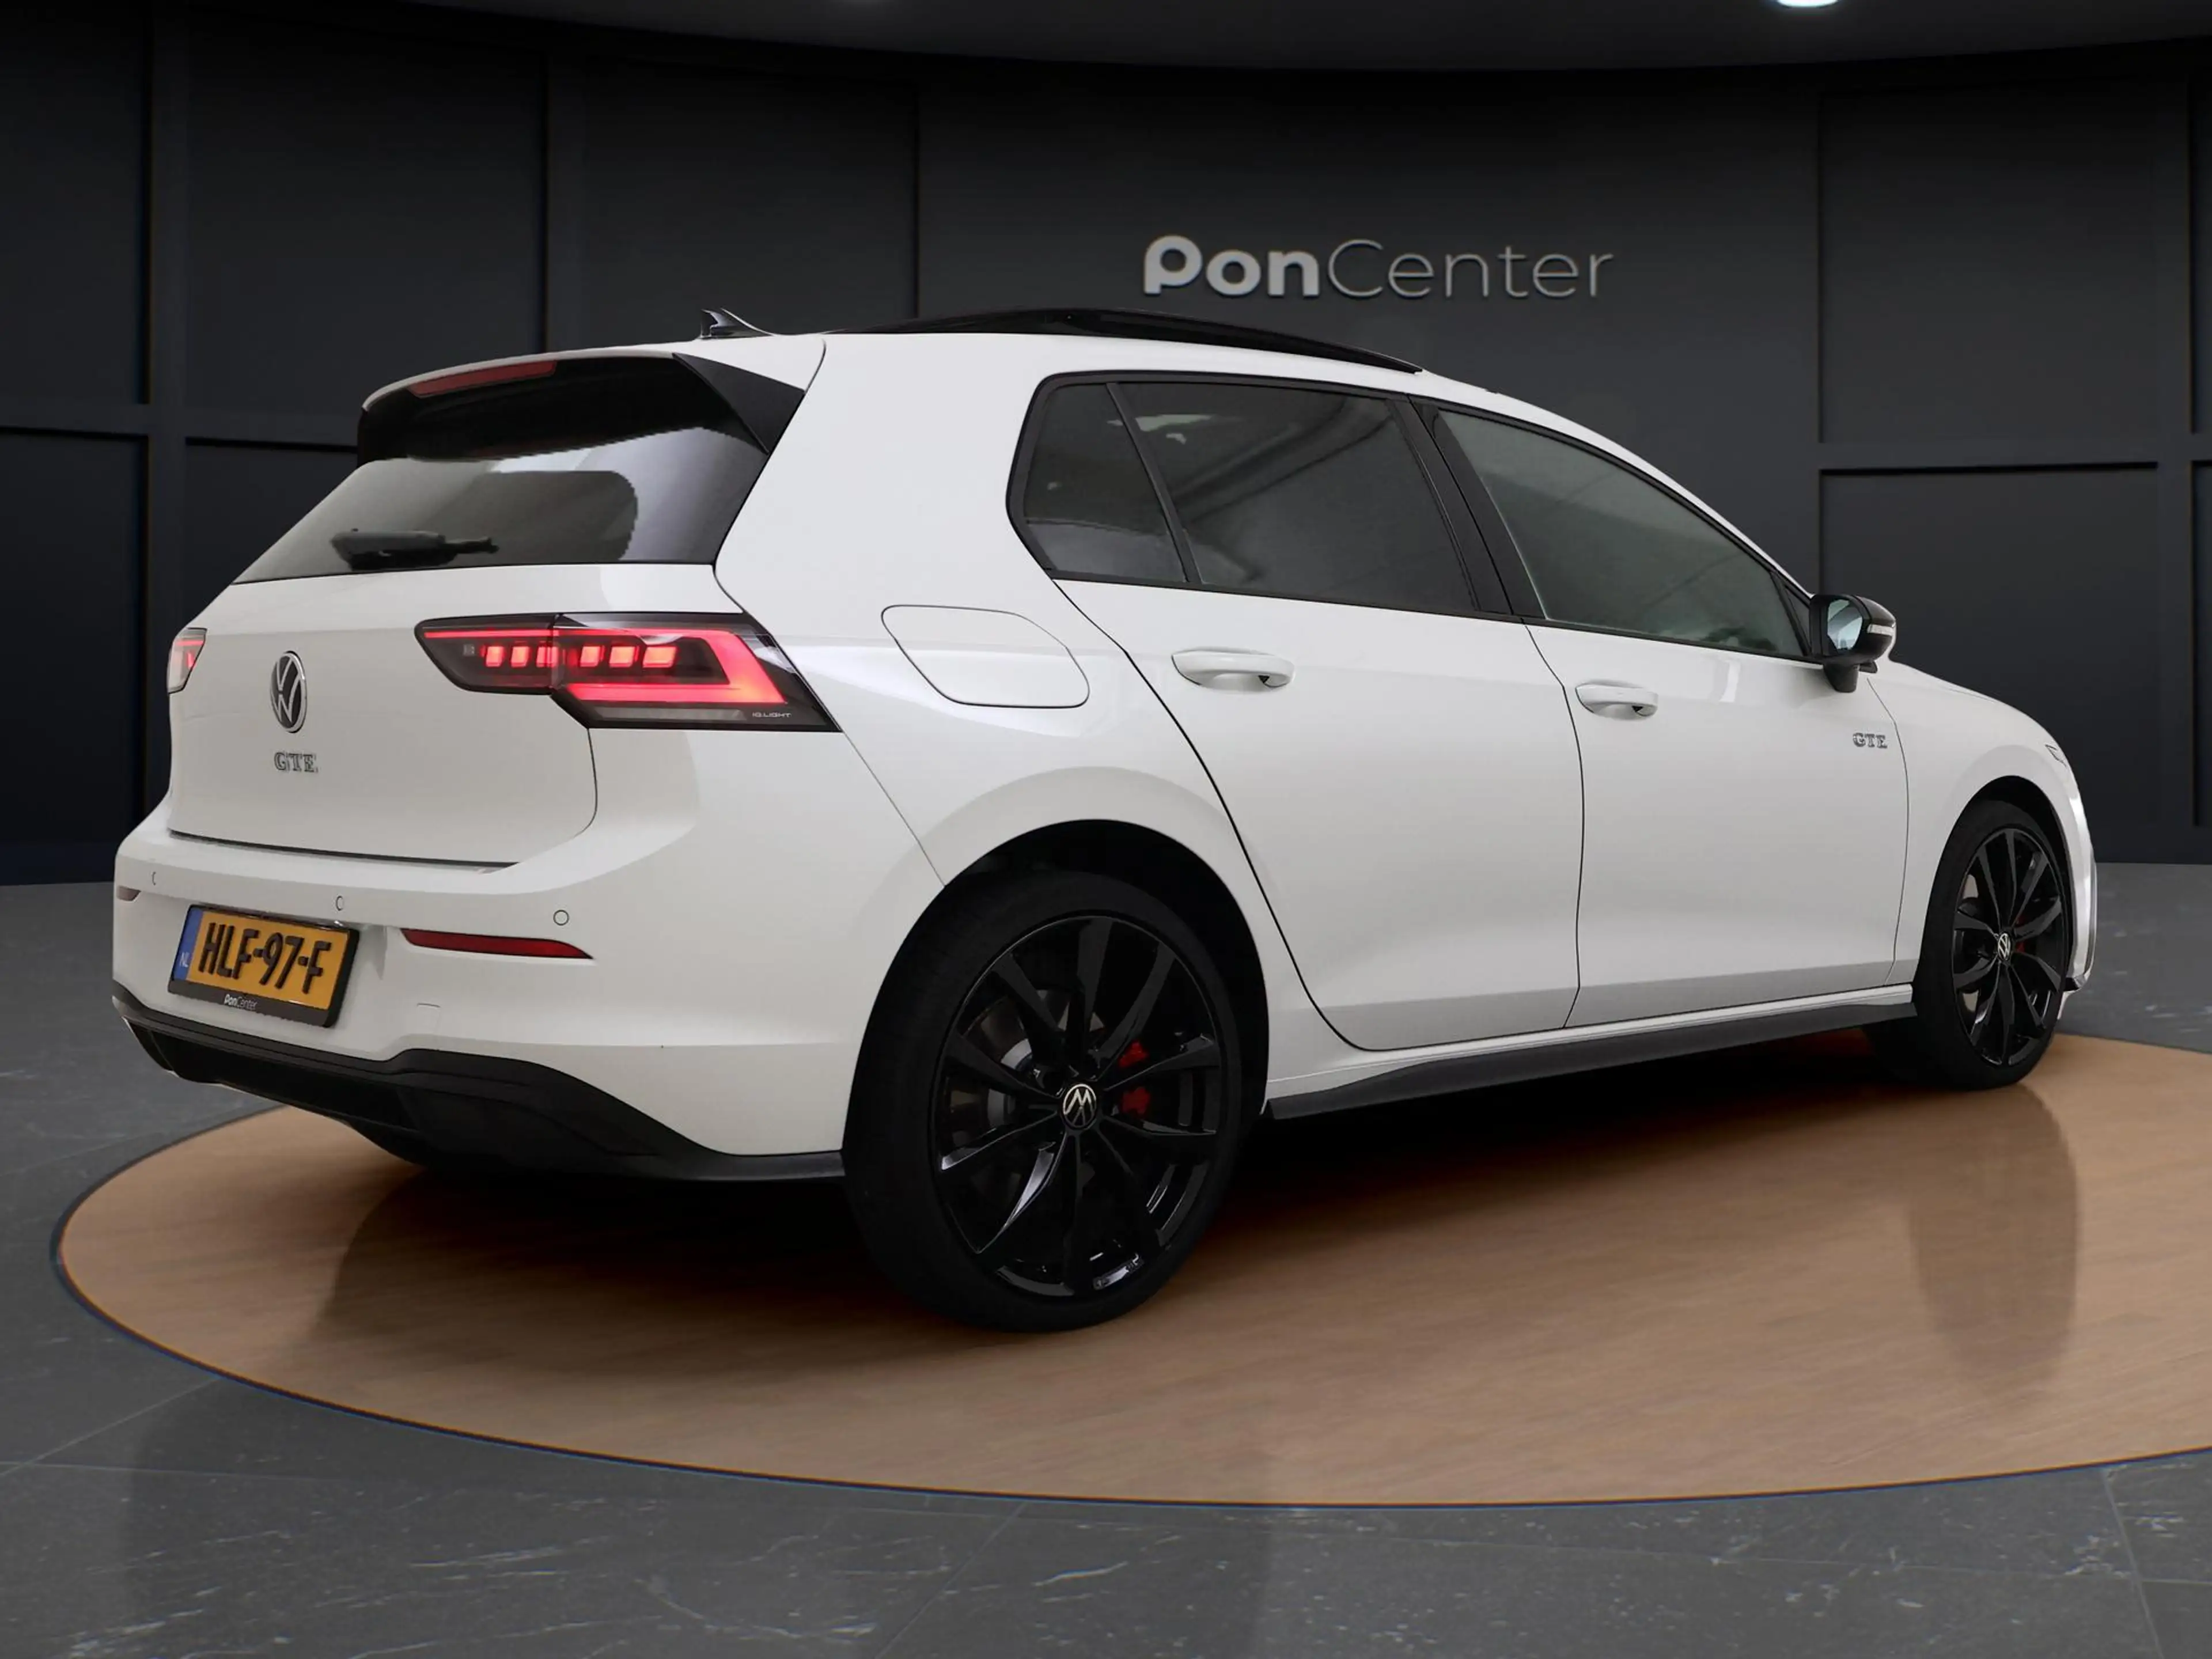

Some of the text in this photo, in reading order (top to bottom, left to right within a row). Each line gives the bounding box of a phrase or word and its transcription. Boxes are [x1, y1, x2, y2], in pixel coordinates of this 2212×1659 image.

[1143, 235, 1613, 298] PonCenter
[1853, 732, 1888, 749] GTE
[274, 752, 318, 773] GTE
[179, 952, 190, 968] NL
[198, 922, 332, 994] HLF-97-F
[224, 993, 258, 1010] PonCenter
